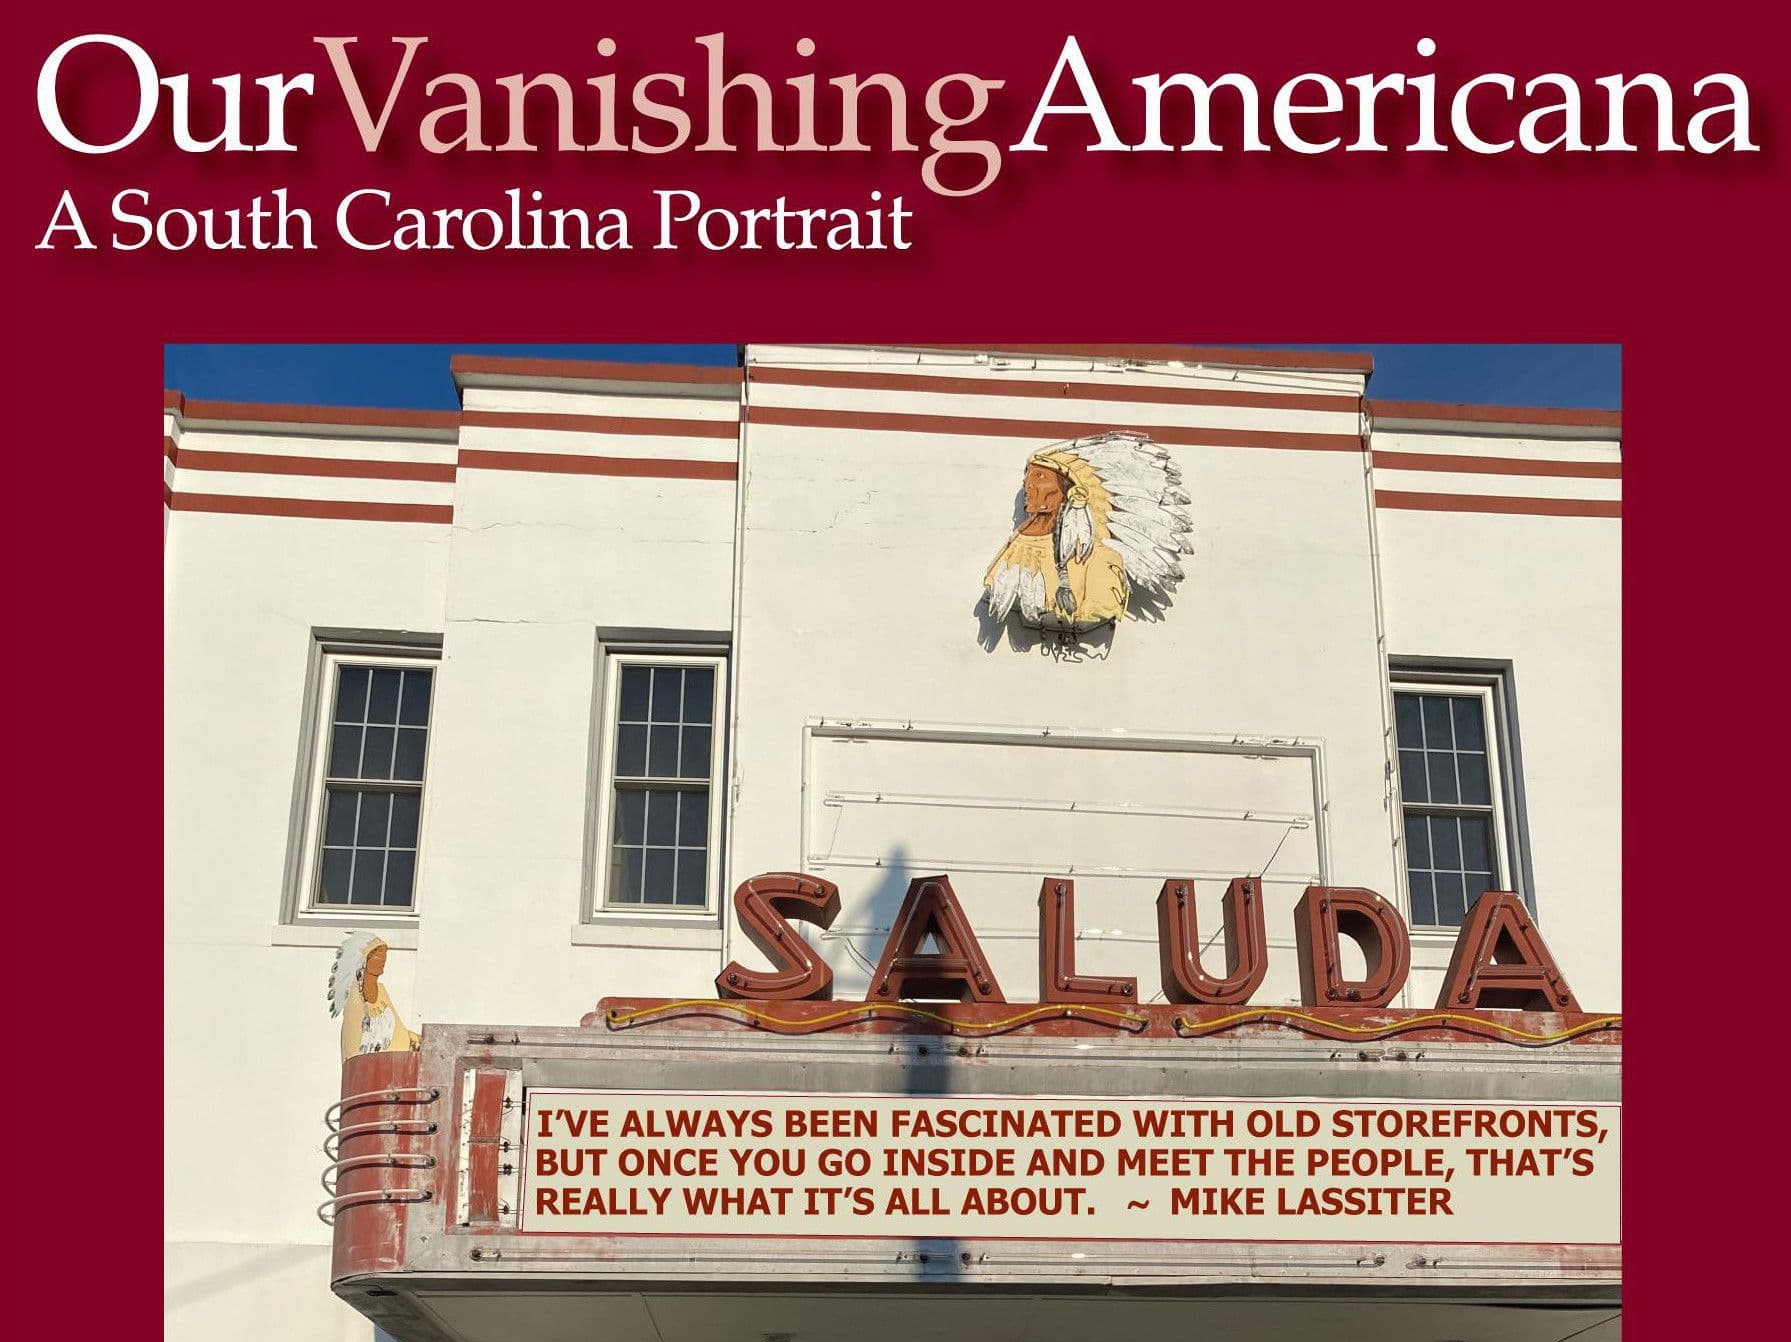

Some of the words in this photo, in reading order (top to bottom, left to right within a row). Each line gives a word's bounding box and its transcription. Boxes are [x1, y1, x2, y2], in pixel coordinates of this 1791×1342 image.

[37, 34, 315, 153] Our
[314, 32, 1006, 197] Vanishing
[1009, 36, 1761, 154] Americana
[35, 190, 97, 249] A
[112, 188, 317, 250] South
[337, 188, 633, 250] Carolina
[653, 188, 912, 250] Portrait
[716, 872, 1581, 1014] SALUDA
[538, 1110, 608, 1137] I’VE
[622, 1111, 772, 1137] ALWAYS
[786, 1111, 877, 1137] BEEN
[893, 1110, 1121, 1137] FASCINATED
[1133, 1111, 1233, 1137] WITH
[1248, 1110, 1320, 1137] OLD
[1333, 1110, 1606, 1141] STOREFRONTS,
[537, 1149, 607, 1176] BUT
[619, 1149, 717, 1176] ONCE
[731, 1149, 805, 1176] YOU
[819, 1149, 870, 1176] GO
[884, 1149, 1014, 1176] INSIDE
[1028, 1149, 1104, 1176] AND
[1119, 1149, 1213, 1176] MEET
[1224, 1149, 1293, 1175] THE
[1308, 1149, 1453, 1181] PEOPLE,
[1466, 1149, 1593, 1176] THAT’S
[537, 1188, 670, 1215] REALLY
[684, 1188, 792, 1214] WHAT
[806, 1187, 874, 1215] IT’S
[886, 1188, 949, 1214] ALL
[962, 1188, 1094, 1215] ABOUT.
[1172, 1188, 1263, 1214] MIKE
[1279, 1188, 1452, 1215] LASSITER
